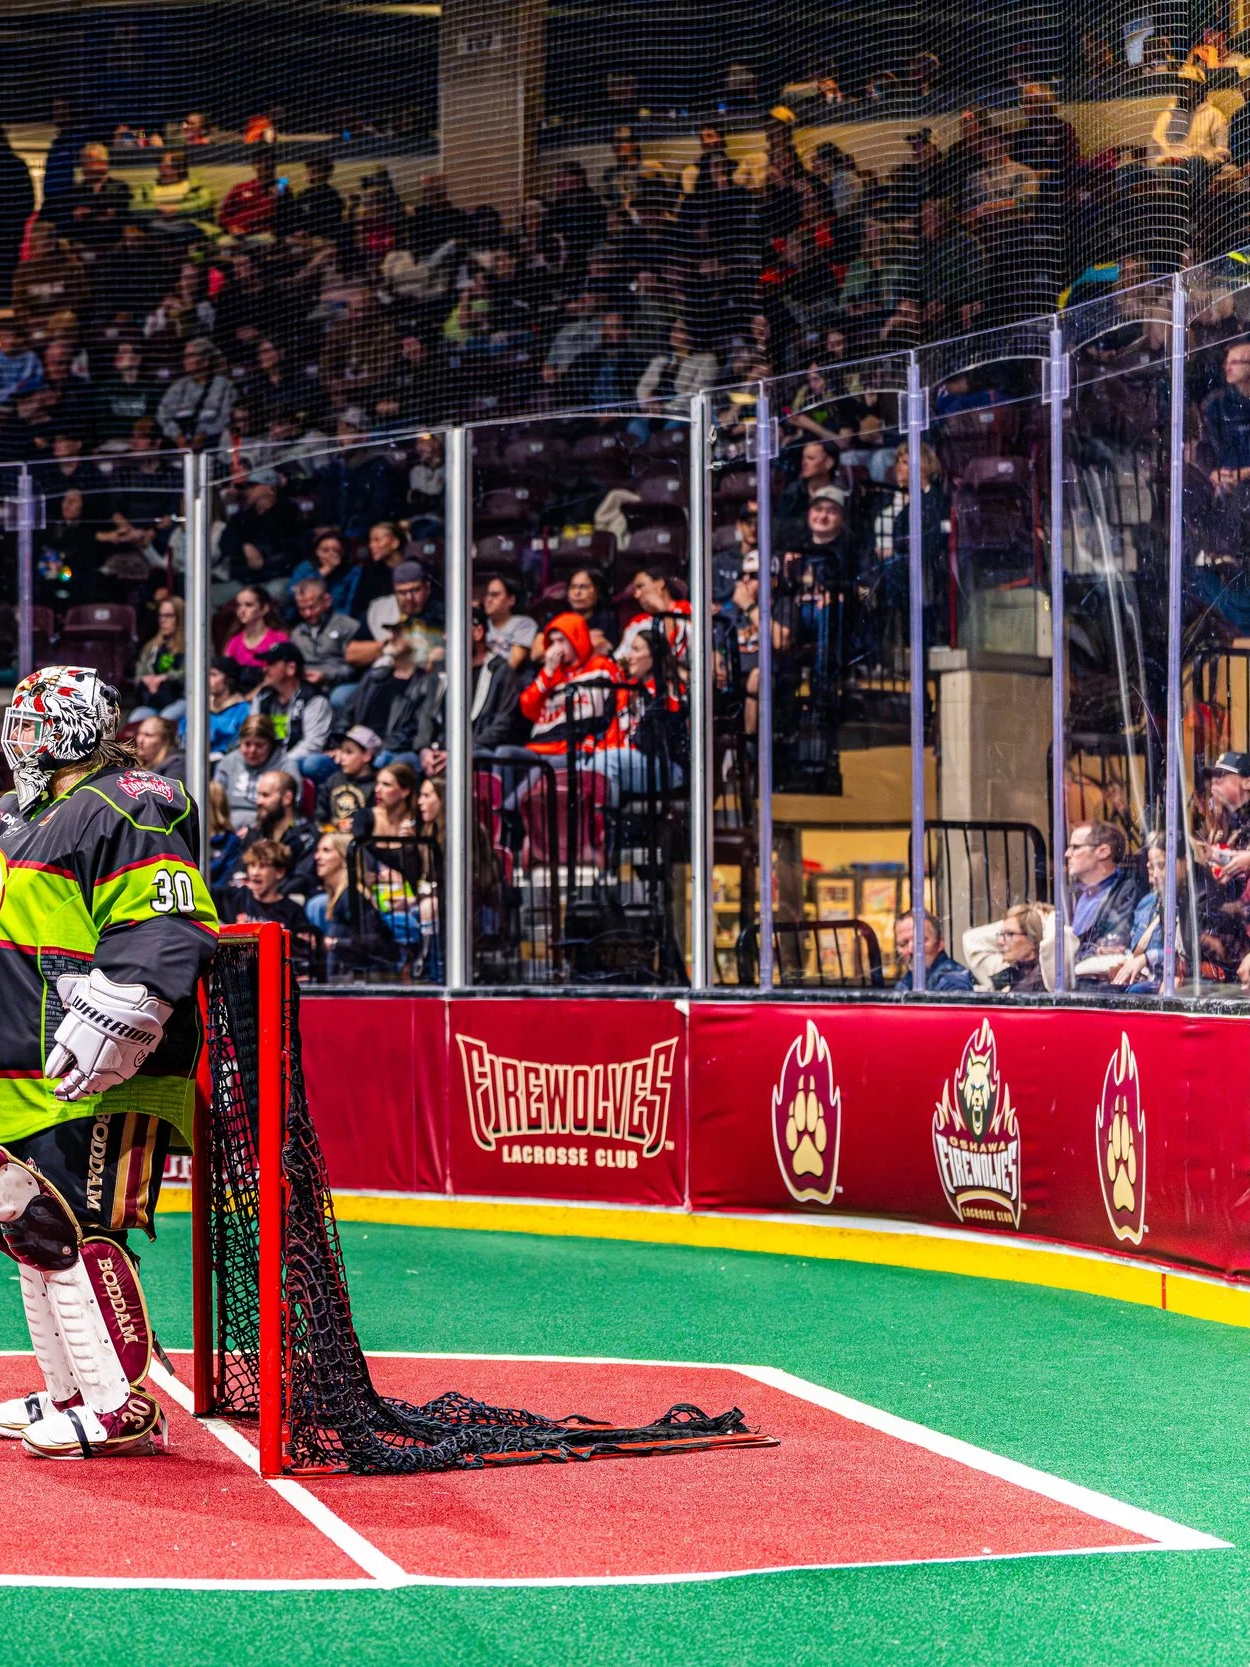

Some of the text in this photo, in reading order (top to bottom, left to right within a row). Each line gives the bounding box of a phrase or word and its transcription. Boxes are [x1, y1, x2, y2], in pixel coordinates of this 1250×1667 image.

[151, 869, 196, 913] 30
[72, 995, 157, 1046] WARRIOR
[455, 1033, 679, 1157] FIREWOLVES
[502, 1145, 638, 1169] LACROSSE CLUB
[949, 1135, 1007, 1152] OSHAWA
[935, 1133, 1018, 1200] FIREWOLVES
[962, 1207, 1013, 1223] LACROSSE CLUB
[97, 1257, 139, 1345] BODDAM
[121, 1399, 151, 1430] 30
